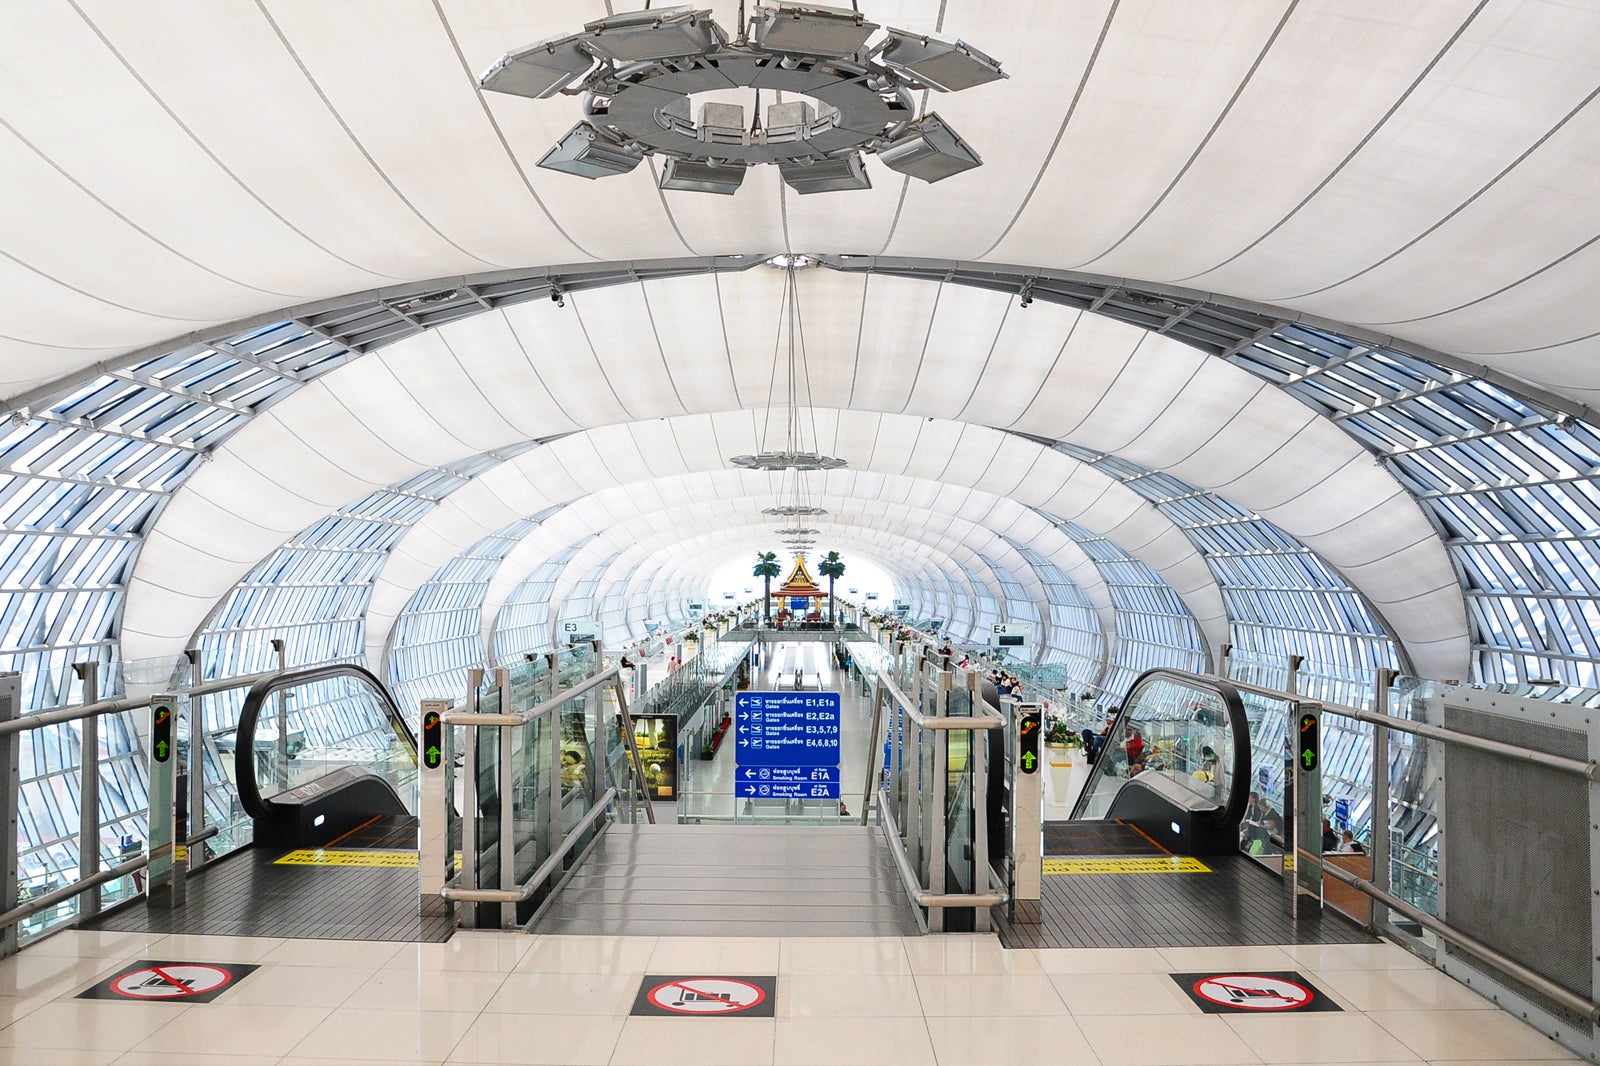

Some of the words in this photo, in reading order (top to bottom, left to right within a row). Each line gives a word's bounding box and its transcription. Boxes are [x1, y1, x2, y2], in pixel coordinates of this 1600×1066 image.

[564, 623, 577, 632] E3
[994, 625, 1006, 634] E4
[806, 699, 834, 707] E1,E1a
[806, 713, 834, 721] E2,E2a
[806, 726, 838, 735] E3,5,7,9
[806, 739, 838, 748] E4,6,8,10
